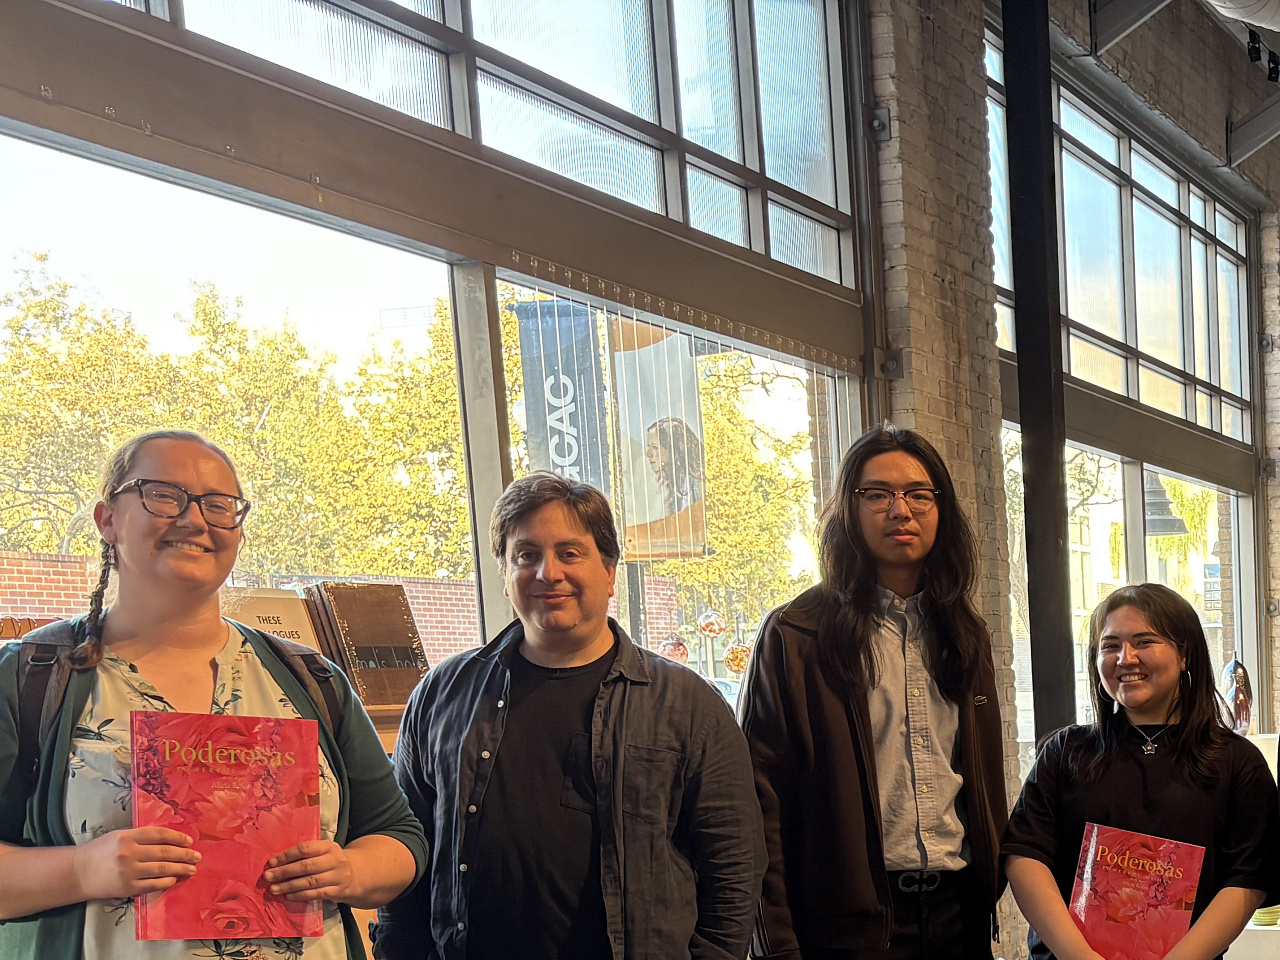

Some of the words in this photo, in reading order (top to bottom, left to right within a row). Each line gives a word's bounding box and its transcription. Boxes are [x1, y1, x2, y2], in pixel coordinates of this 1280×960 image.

[256, 615, 283, 625] THESE
[164, 739, 296, 767] Poderosas
[1096, 845, 1184, 879] Poderosas
